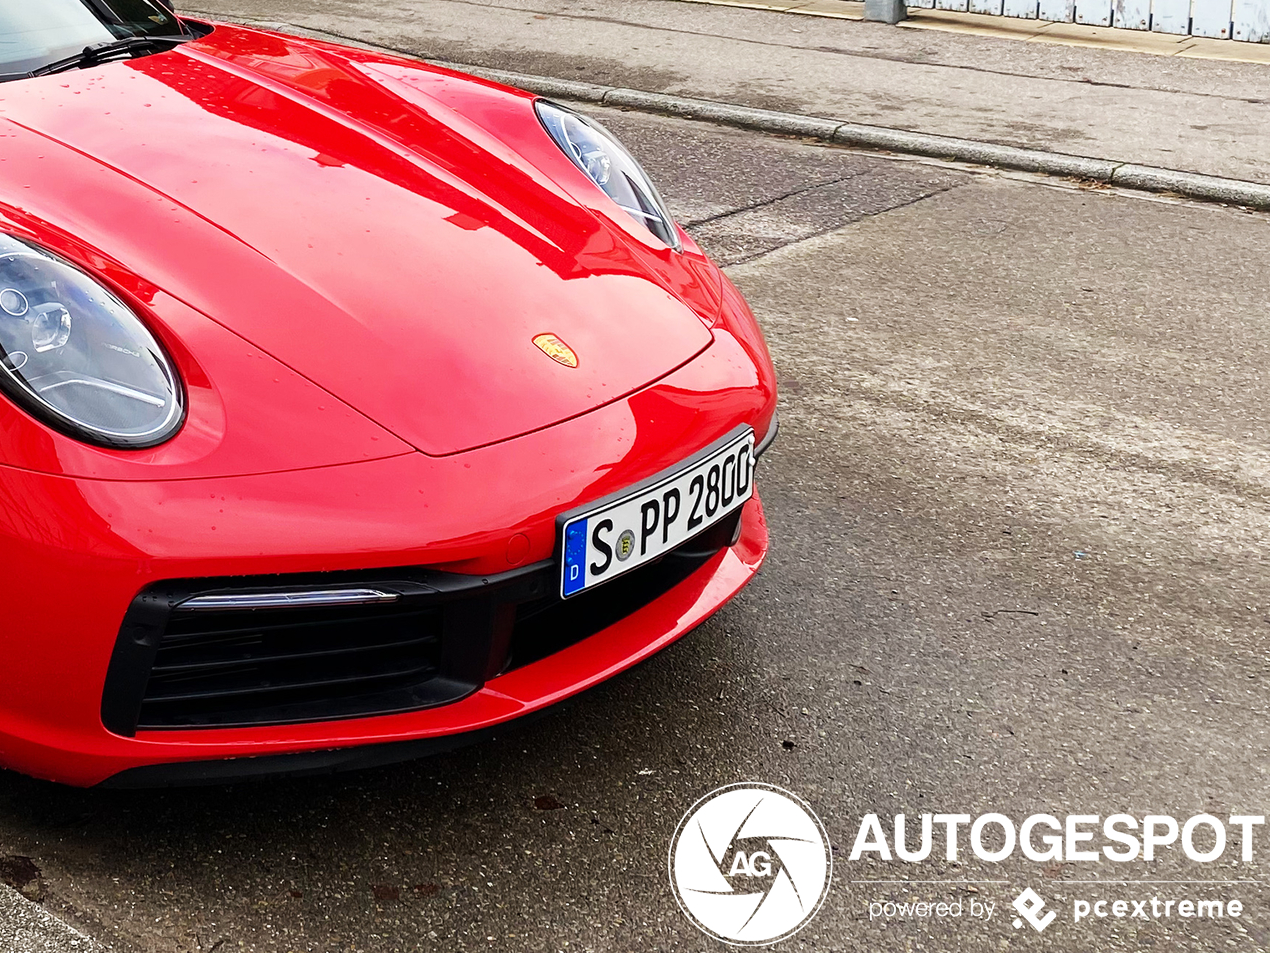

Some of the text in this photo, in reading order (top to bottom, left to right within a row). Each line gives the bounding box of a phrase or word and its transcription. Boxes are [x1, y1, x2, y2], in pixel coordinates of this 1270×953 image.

[590, 443, 750, 576] S PP 2800
[570, 565, 579, 581] D
